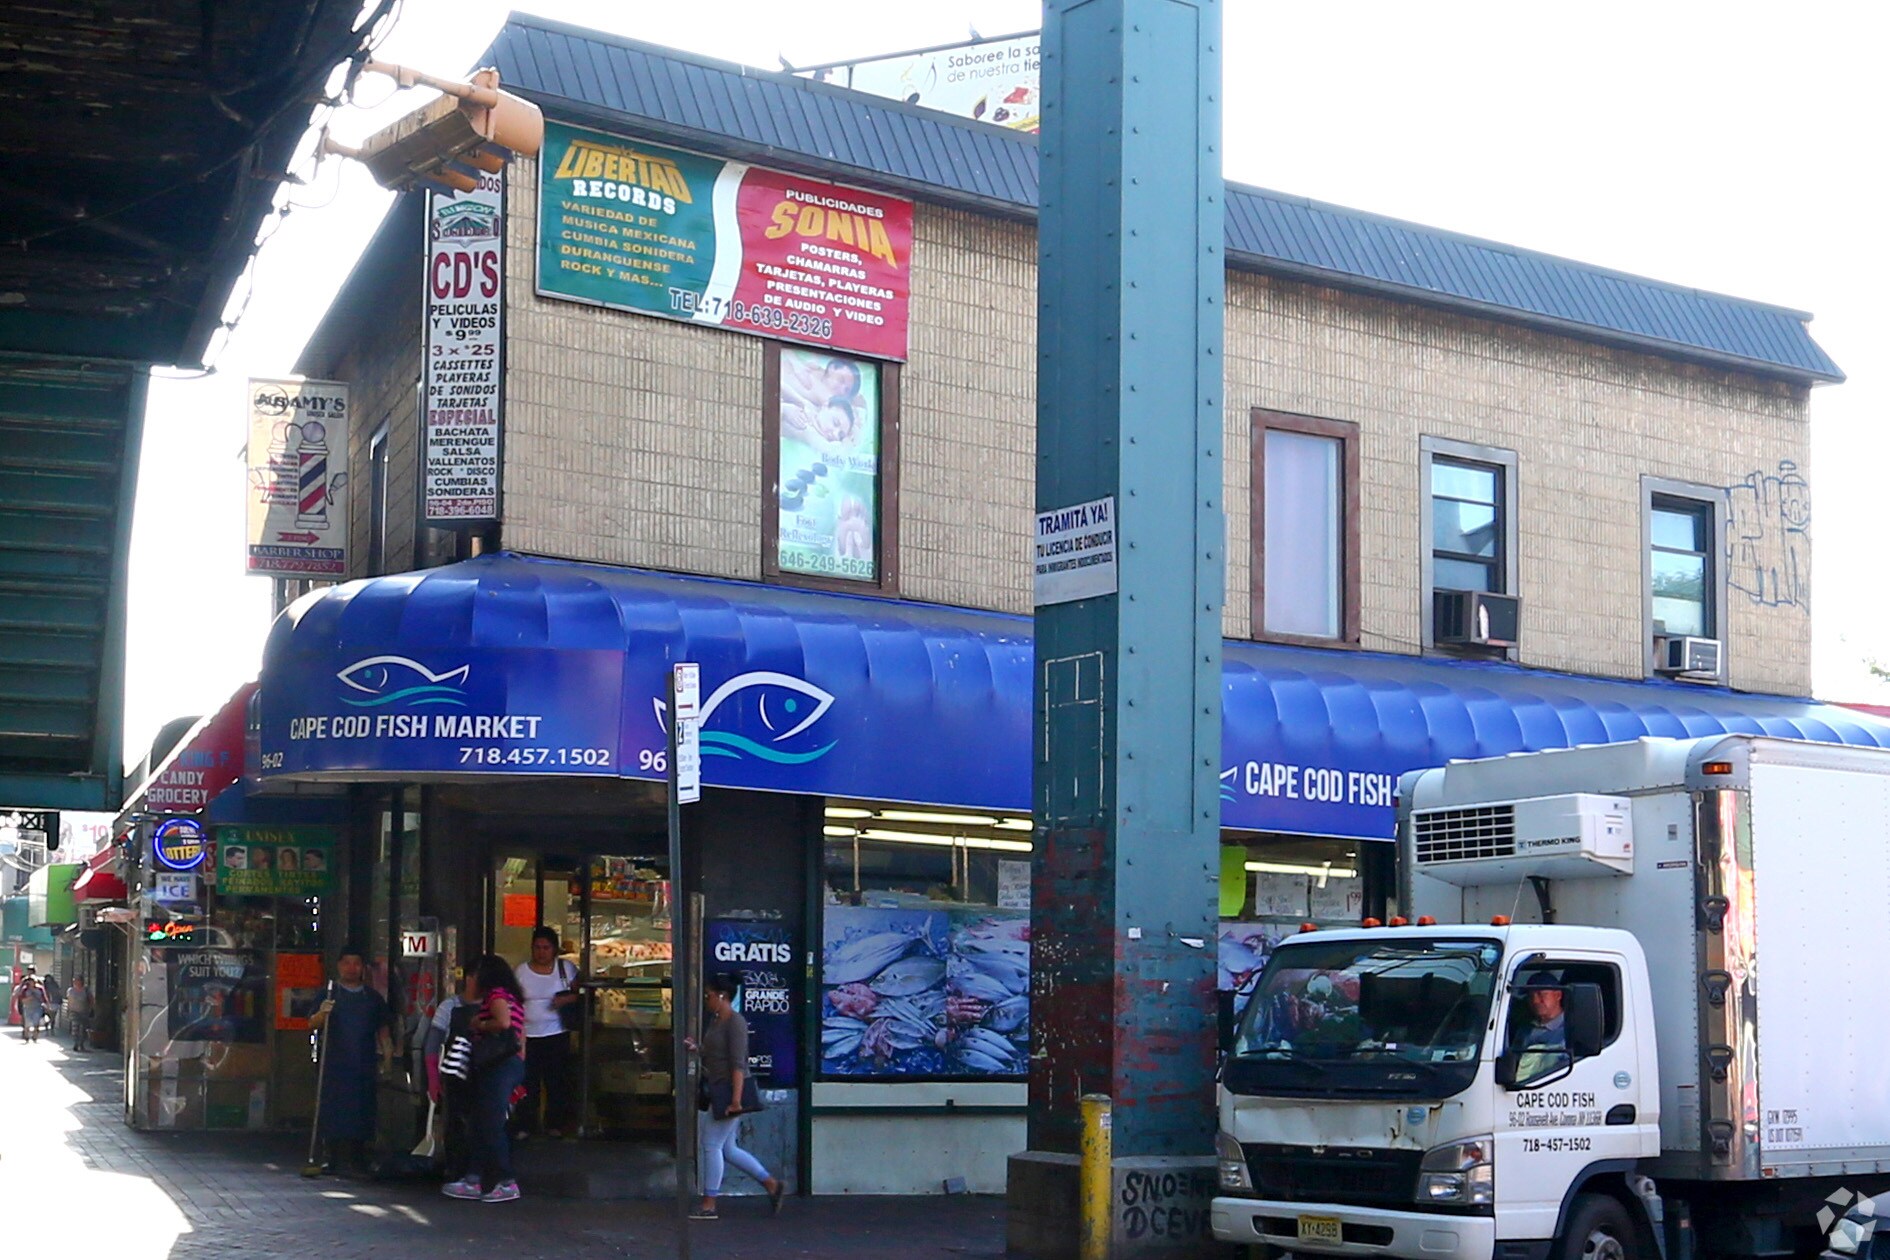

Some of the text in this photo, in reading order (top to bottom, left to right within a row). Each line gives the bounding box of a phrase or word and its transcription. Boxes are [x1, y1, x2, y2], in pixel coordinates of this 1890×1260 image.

[948, 50, 1004, 68] Saboree
[1008, 46, 1021, 61] la
[947, 69, 966, 83] de
[969, 62, 1020, 80] nuestra
[554, 140, 693, 204] LIBERTAD
[573, 179, 676, 215] RECORDS
[785, 189, 885, 219] PUBLICIDADES
[561, 201, 658, 227] VARIEDAD DE
[561, 215, 697, 251] MUSICA MEXICANA
[764, 200, 899, 271] SONIA
[561, 230, 695, 264] CUMBIA SONIDERA
[801, 242, 863, 266] POSTERS,
[560, 244, 672, 273] DURANGUENSE
[786, 254, 867, 280] CHAMARRAS
[432, 250, 499, 300] CD'S
[560, 259, 664, 288] ROCK Y MAS...
[755, 262, 895, 300] TARJETAS, PLAYERAS
[766, 280, 883, 312] PRESENTACIONES
[430, 303, 498, 316] PELICULAS
[763, 294, 885, 327] DE AUDIO Y VIDEO
[432, 317, 496, 329] Y VIDEOS
[432, 345, 443, 356] 3
[433, 359, 494, 371] CASSETTES
[436, 372, 491, 383] PLAYERAS
[429, 384, 497, 396] DE SONIDOS
[436, 397, 489, 408] TARJETAS
[429, 437, 495, 447] MERENGUE
[435, 428, 490, 437] BACHATA
[442, 447, 482, 456] SALSA
[428, 457, 496, 466] VALLENATOS
[427, 467, 496, 476] ROCK DISCO
[434, 477, 488, 487] CUMBIAS
[427, 487, 495, 497] SONIDERAS
[1090, 502, 1108, 525] YA!
[253, 546, 342, 560] BARBER SHOP
[1037, 545, 1045, 558] TU
[1046, 539, 1074, 557] LICENCIA
[780, 550, 875, 577] 646-249-5626
[290, 714, 542, 740] CAPE COD FISH MARKET
[261, 752, 284, 769] 96-02
[459, 747, 611, 767] 718.457.1502
[160, 770, 204, 786] CANDY
[1245, 760, 1392, 807] CAPE COD FISH
[147, 788, 209, 804] GROCERY
[1527, 836, 1581, 848] THERMO KING
[162, 885, 190, 898] ICE
[715, 942, 791, 963] GRATIS
[1517, 1092, 1595, 1108] CAPE COD FISH
[1523, 1138, 1591, 1152] 718-457-1502
